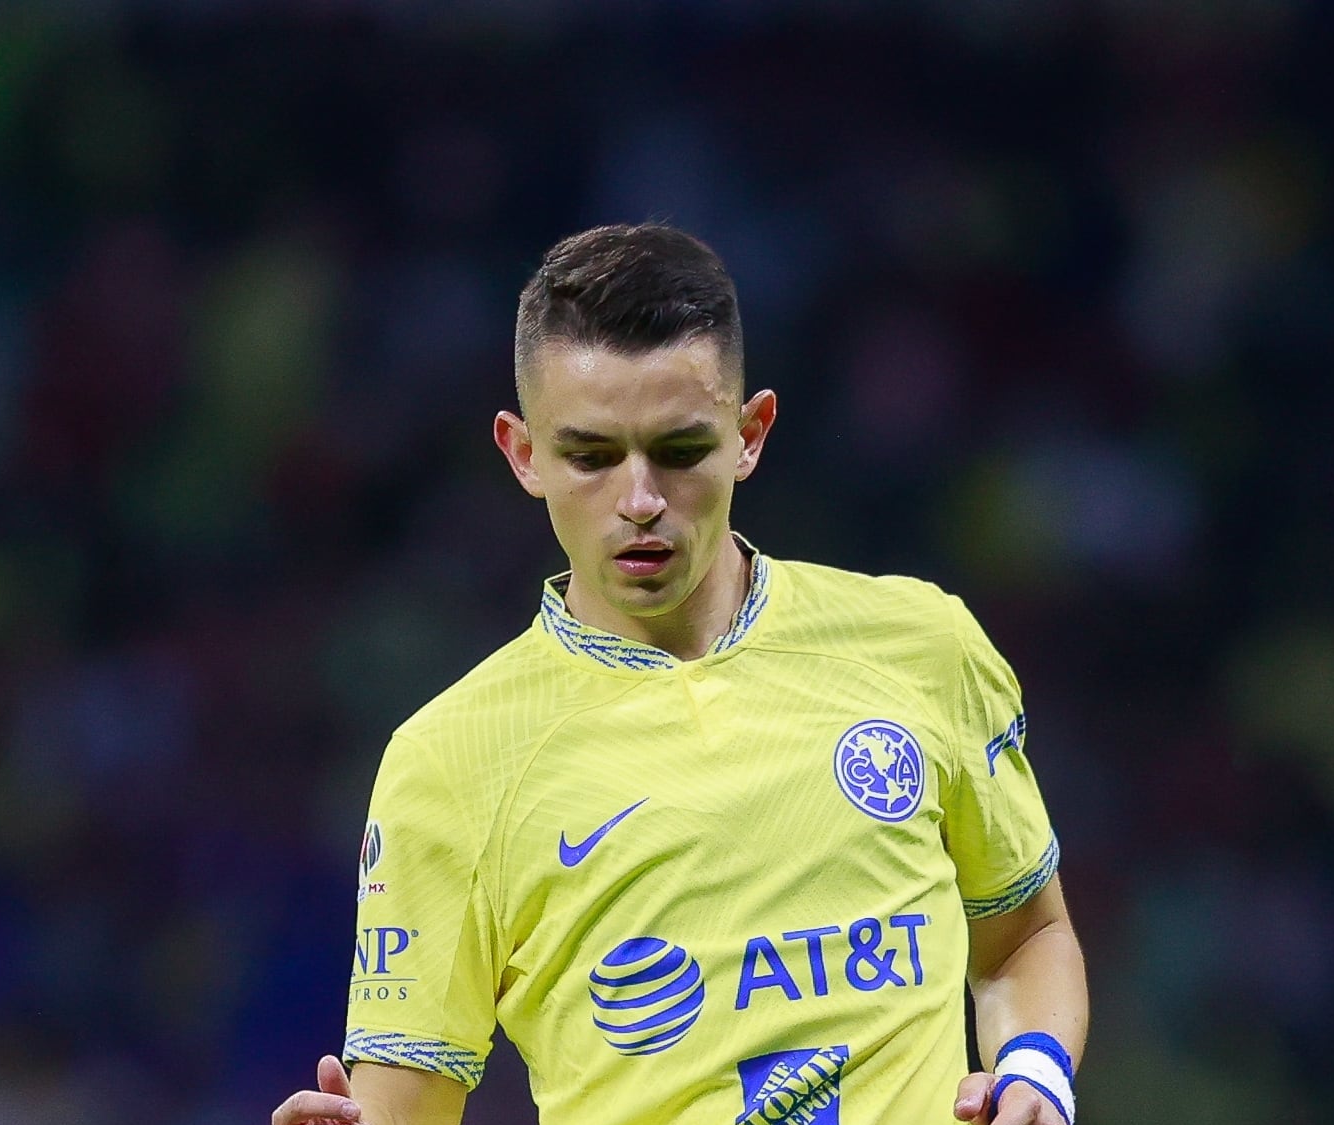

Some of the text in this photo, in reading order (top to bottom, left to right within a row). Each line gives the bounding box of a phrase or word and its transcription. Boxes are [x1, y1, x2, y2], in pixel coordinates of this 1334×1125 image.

[368, 883, 386, 893] MX
[353, 926, 410, 976] NP
[734, 913, 928, 1010] AT&T
[752, 1061, 795, 1103] THE
